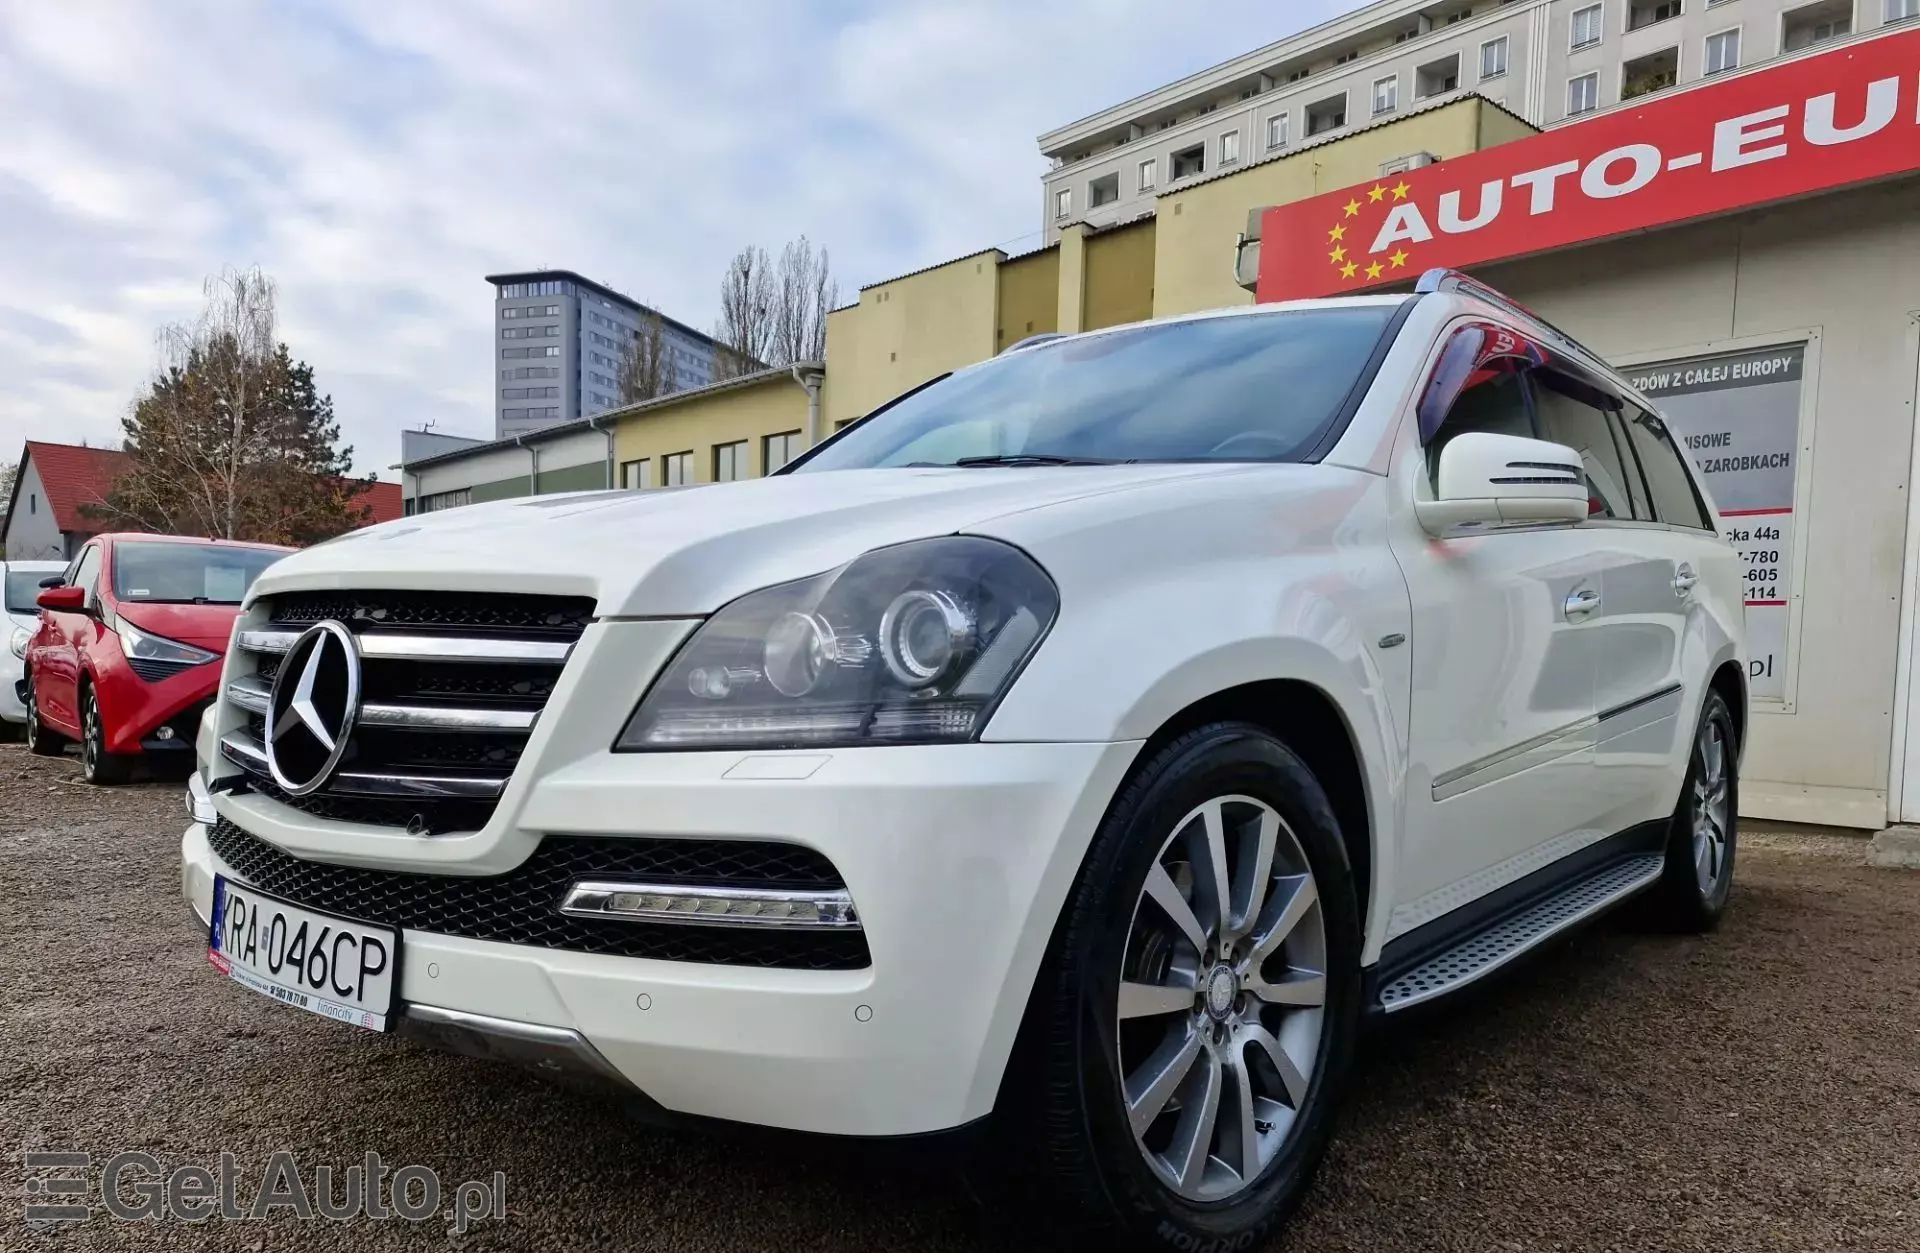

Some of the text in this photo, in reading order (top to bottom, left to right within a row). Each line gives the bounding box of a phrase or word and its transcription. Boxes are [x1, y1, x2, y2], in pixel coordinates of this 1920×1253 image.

[1369, 70, 1920, 253] AUTO-EU
[1672, 372, 1682, 387] Z
[1685, 365, 1729, 385] CAŁEJ
[1732, 357, 1792, 379] EUROPY
[1704, 452, 1790, 474] ZAROBKACH
[1754, 527, 1779, 541] 44a
[268, 913, 387, 1002] 046CP
